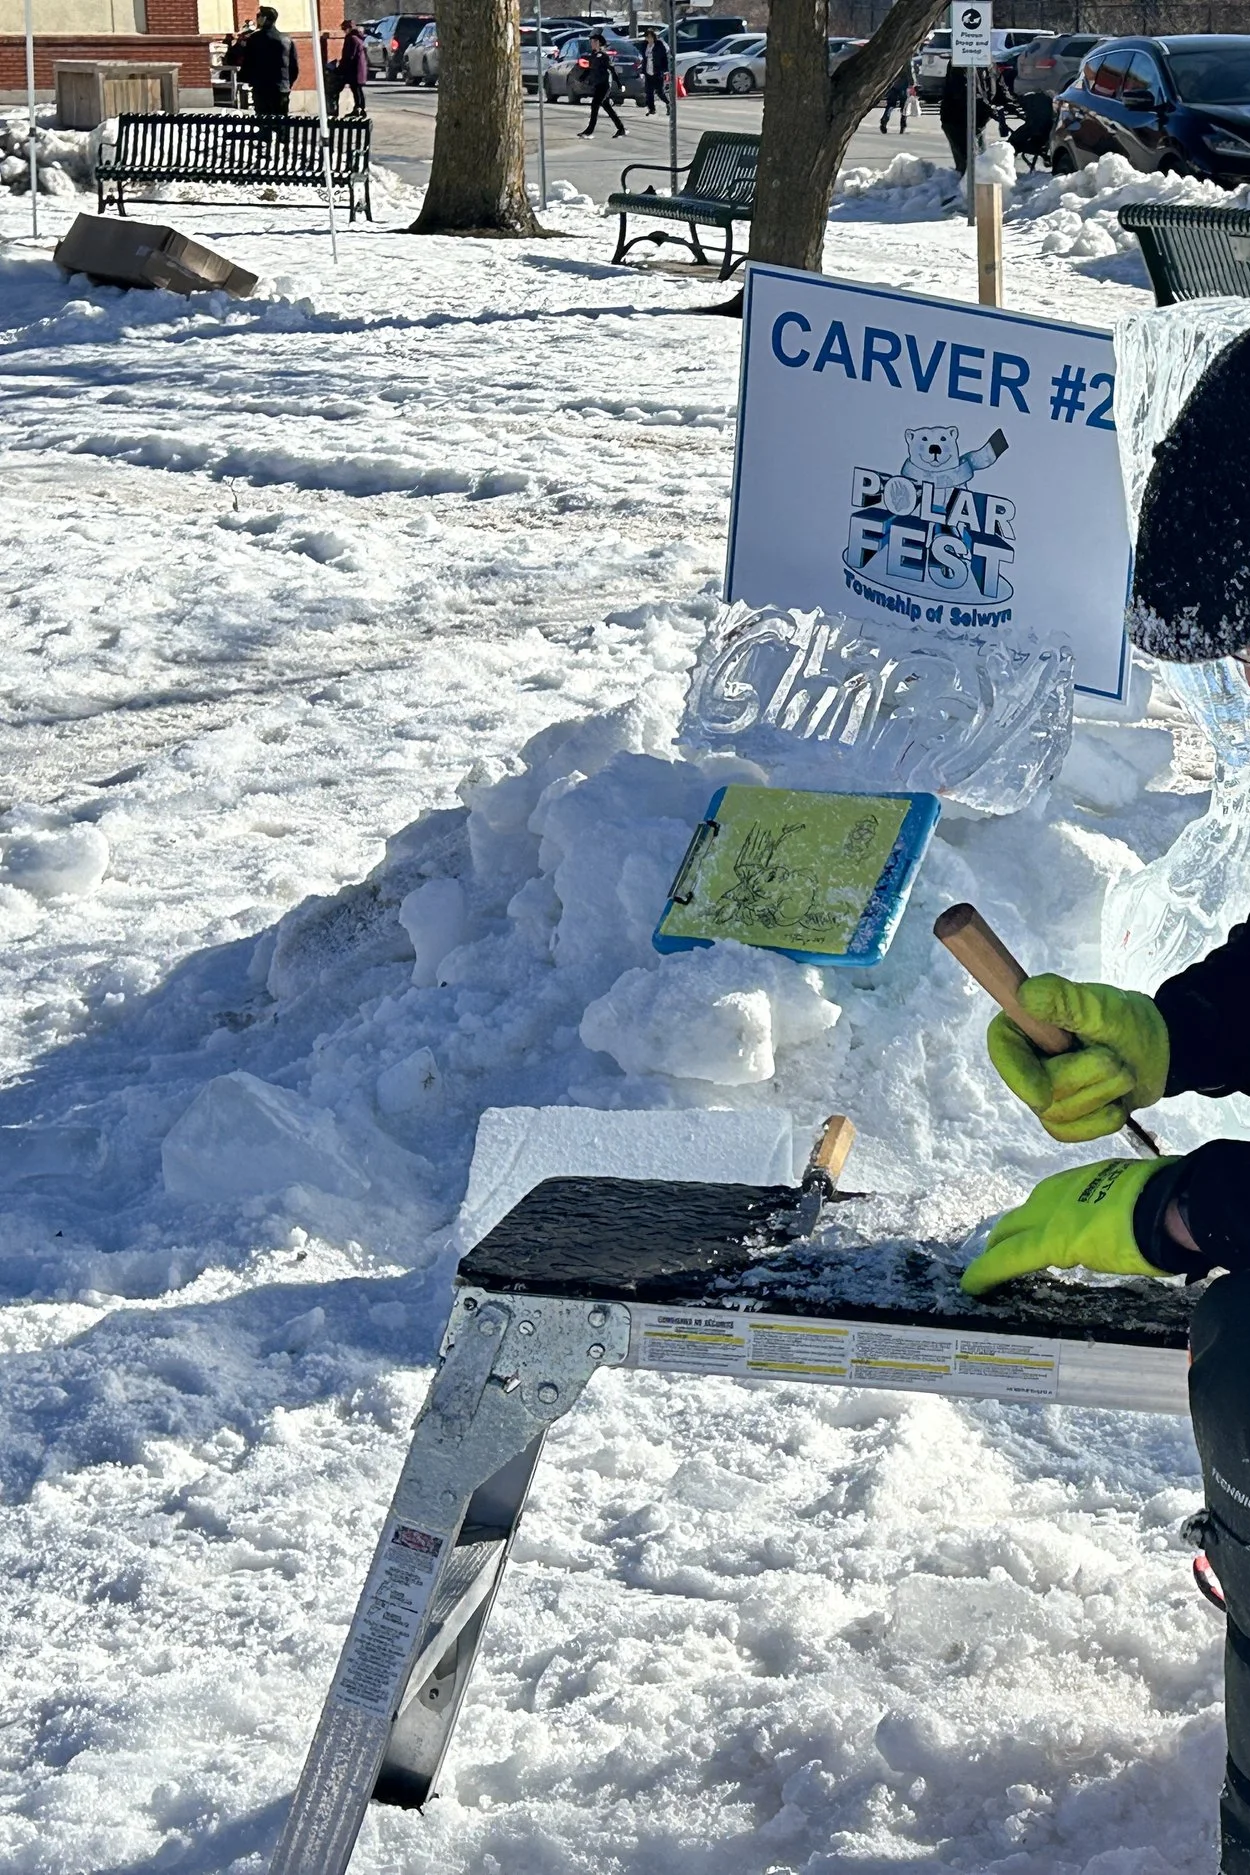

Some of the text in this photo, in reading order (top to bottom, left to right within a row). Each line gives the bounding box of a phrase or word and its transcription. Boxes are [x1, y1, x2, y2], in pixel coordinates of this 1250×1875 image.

[771, 311, 1117, 431] CARVER #2
[851, 466, 1017, 541] POLAR
[843, 567, 922, 622] Township
[925, 605, 944, 624] of
[847, 510, 1016, 599] FEST
